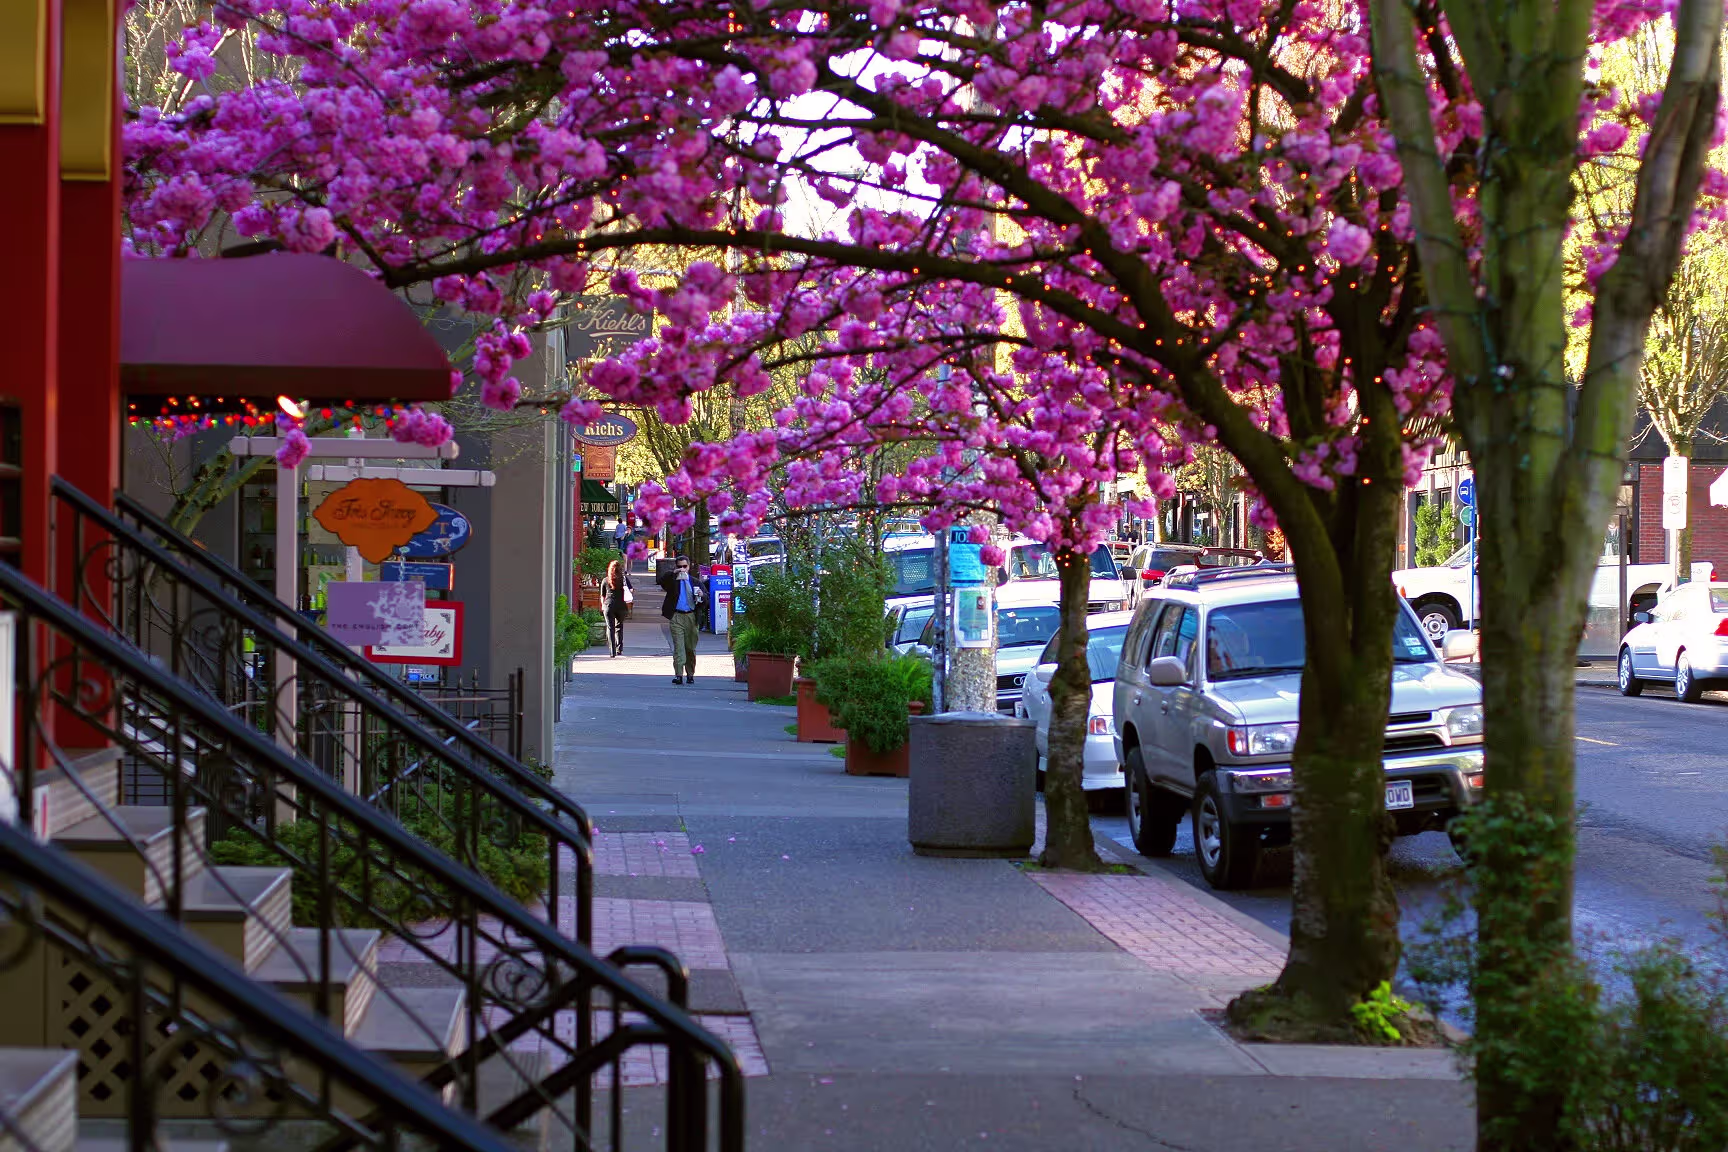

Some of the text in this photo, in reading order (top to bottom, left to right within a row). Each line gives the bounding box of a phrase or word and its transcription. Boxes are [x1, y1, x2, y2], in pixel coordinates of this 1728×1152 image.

[577, 309, 646, 331] Kiehl's
[584, 422, 624, 436] Rich's
[580, 502, 619, 513] EW YORK DELI
[954, 531, 969, 543] JO
[423, 624, 446, 646] aby
